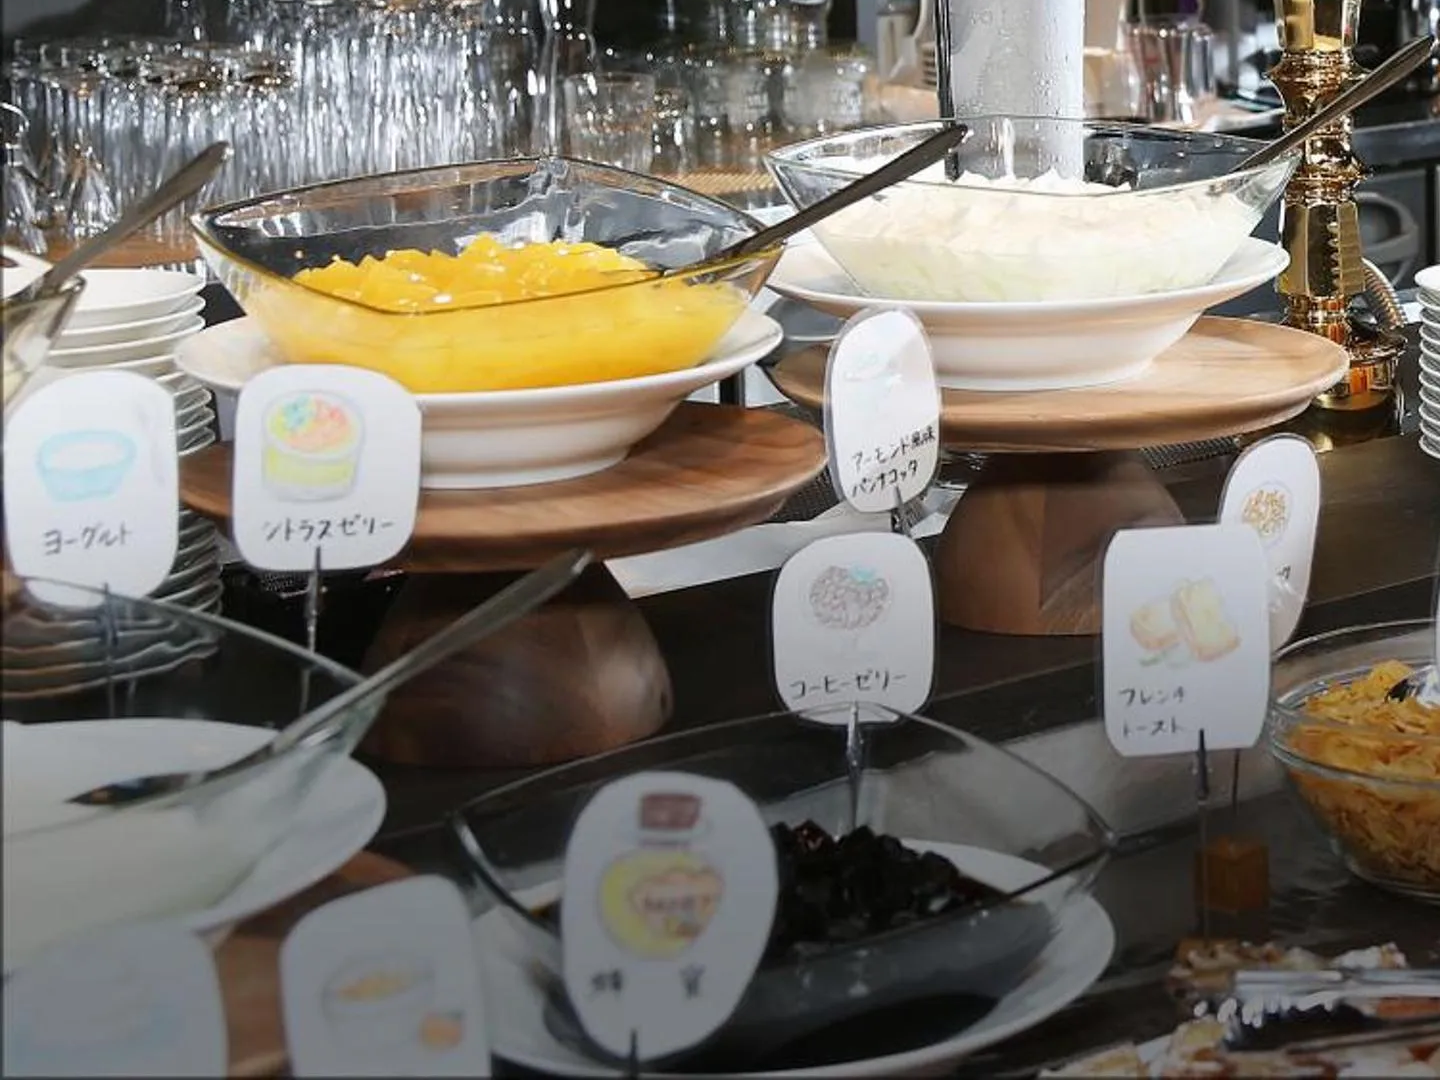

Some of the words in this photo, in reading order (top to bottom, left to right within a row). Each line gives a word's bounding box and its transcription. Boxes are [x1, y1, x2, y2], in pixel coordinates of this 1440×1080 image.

[44, 522, 133, 555] ヨーグルト
[789, 668, 907, 700] コーヒーゼリー
[1123, 718, 1185, 738] トースト
